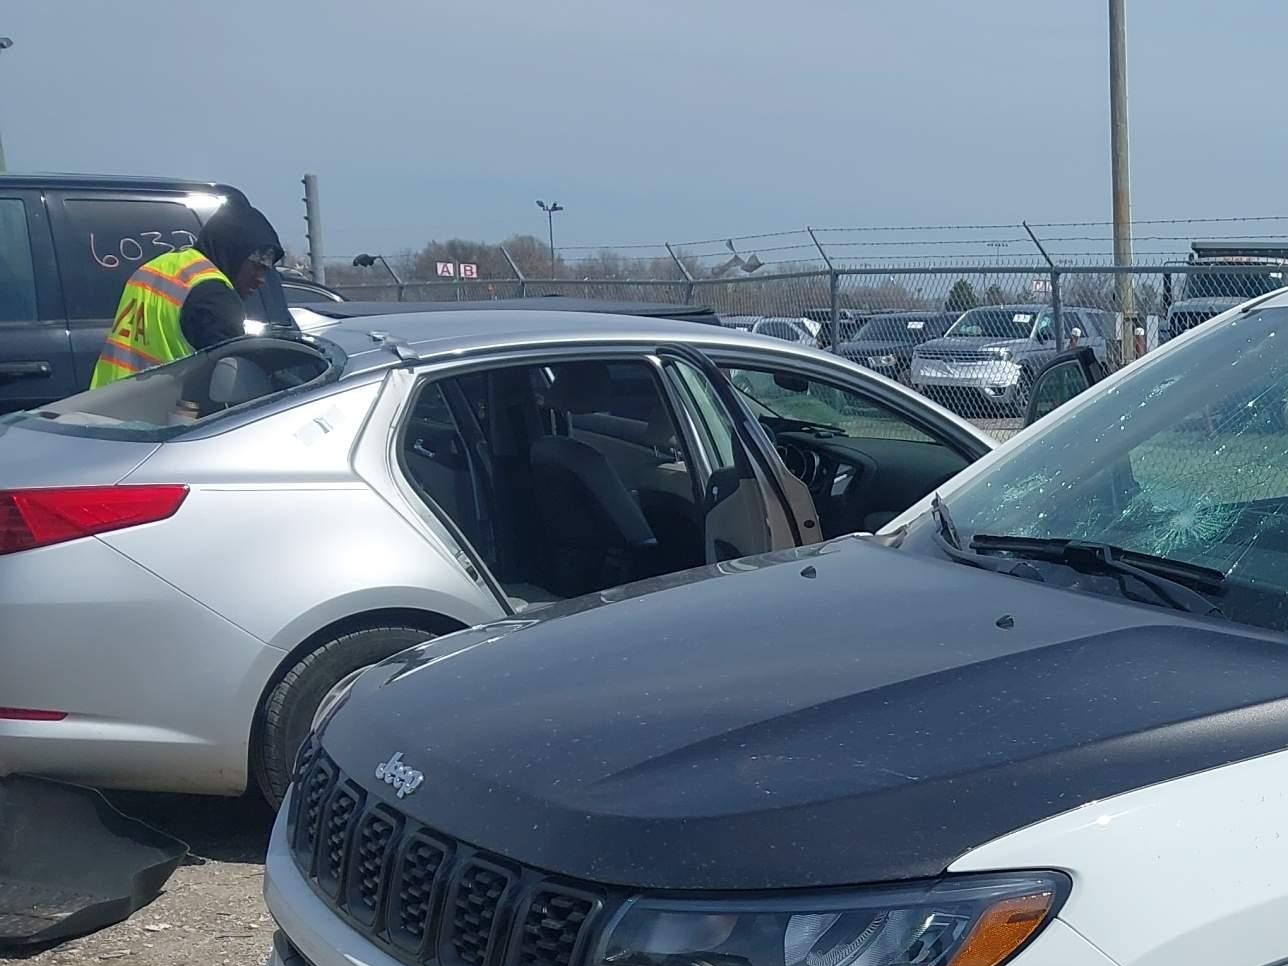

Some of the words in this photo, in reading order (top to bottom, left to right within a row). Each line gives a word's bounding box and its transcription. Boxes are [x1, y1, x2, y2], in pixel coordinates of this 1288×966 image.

[441, 263, 451, 276] A
[464, 265, 474, 276] B
[375, 751, 424, 799] Jeep
